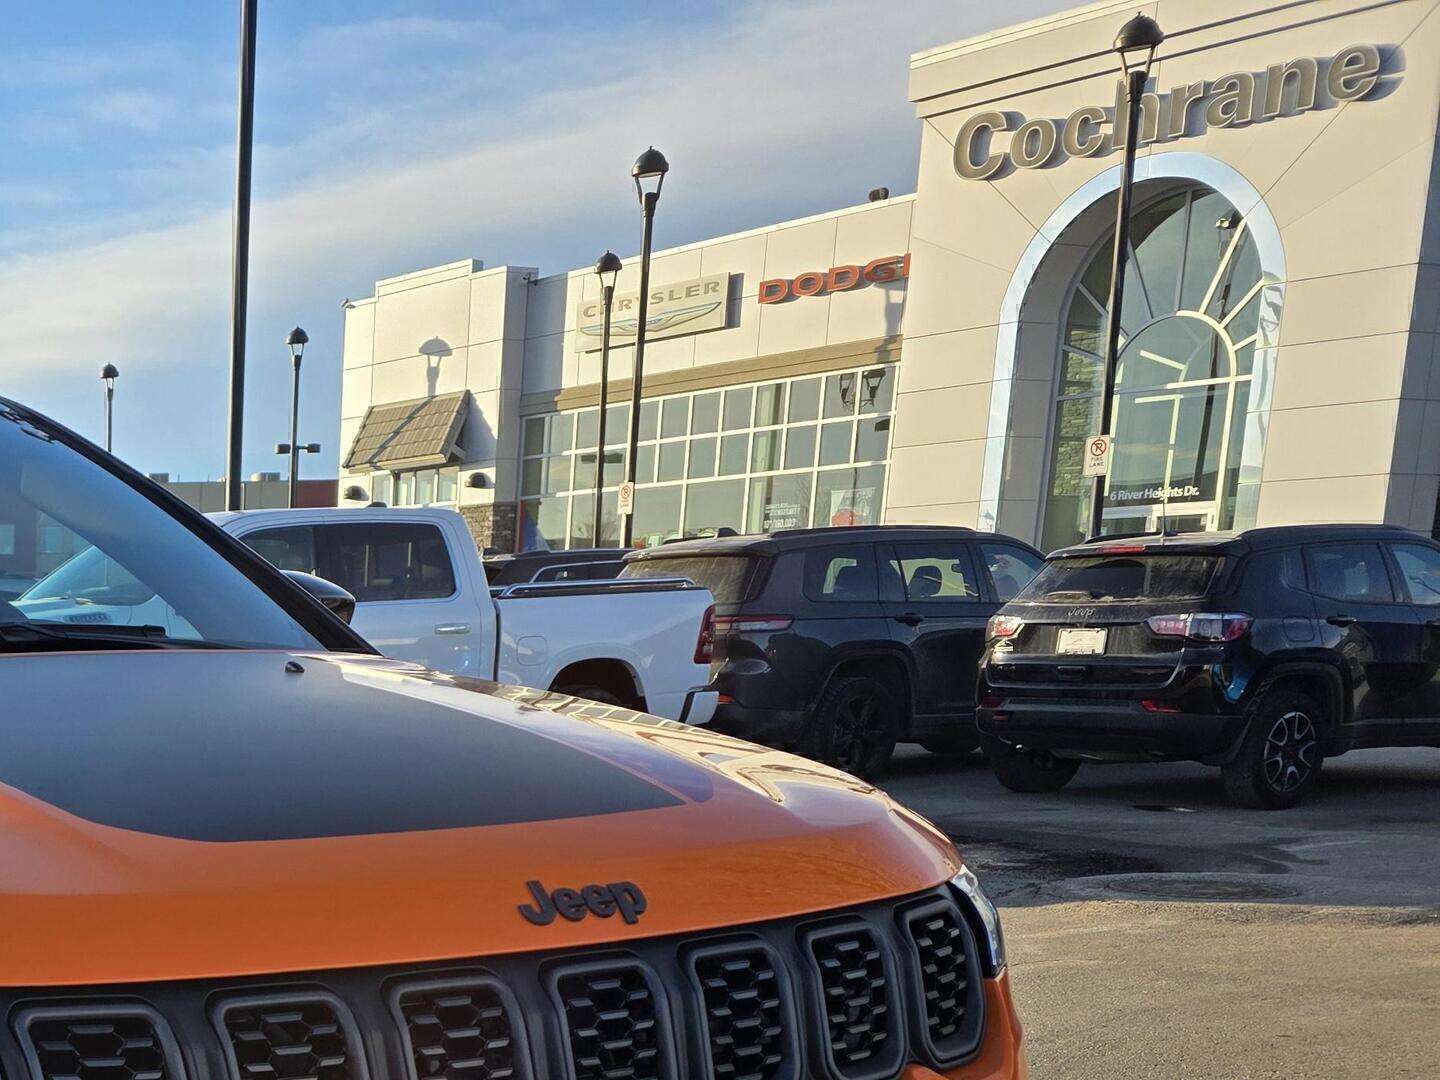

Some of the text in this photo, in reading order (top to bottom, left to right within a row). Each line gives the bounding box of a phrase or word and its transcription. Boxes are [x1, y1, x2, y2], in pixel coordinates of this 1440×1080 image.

[953, 43, 1380, 181] Cochrane
[758, 252, 912, 304] DODG
[583, 281, 721, 318] CRSLER
[1110, 485, 1200, 501] 6 River Heights Dr.
[1067, 607, 1096, 619] Jeep
[517, 879, 647, 926] Jeep
